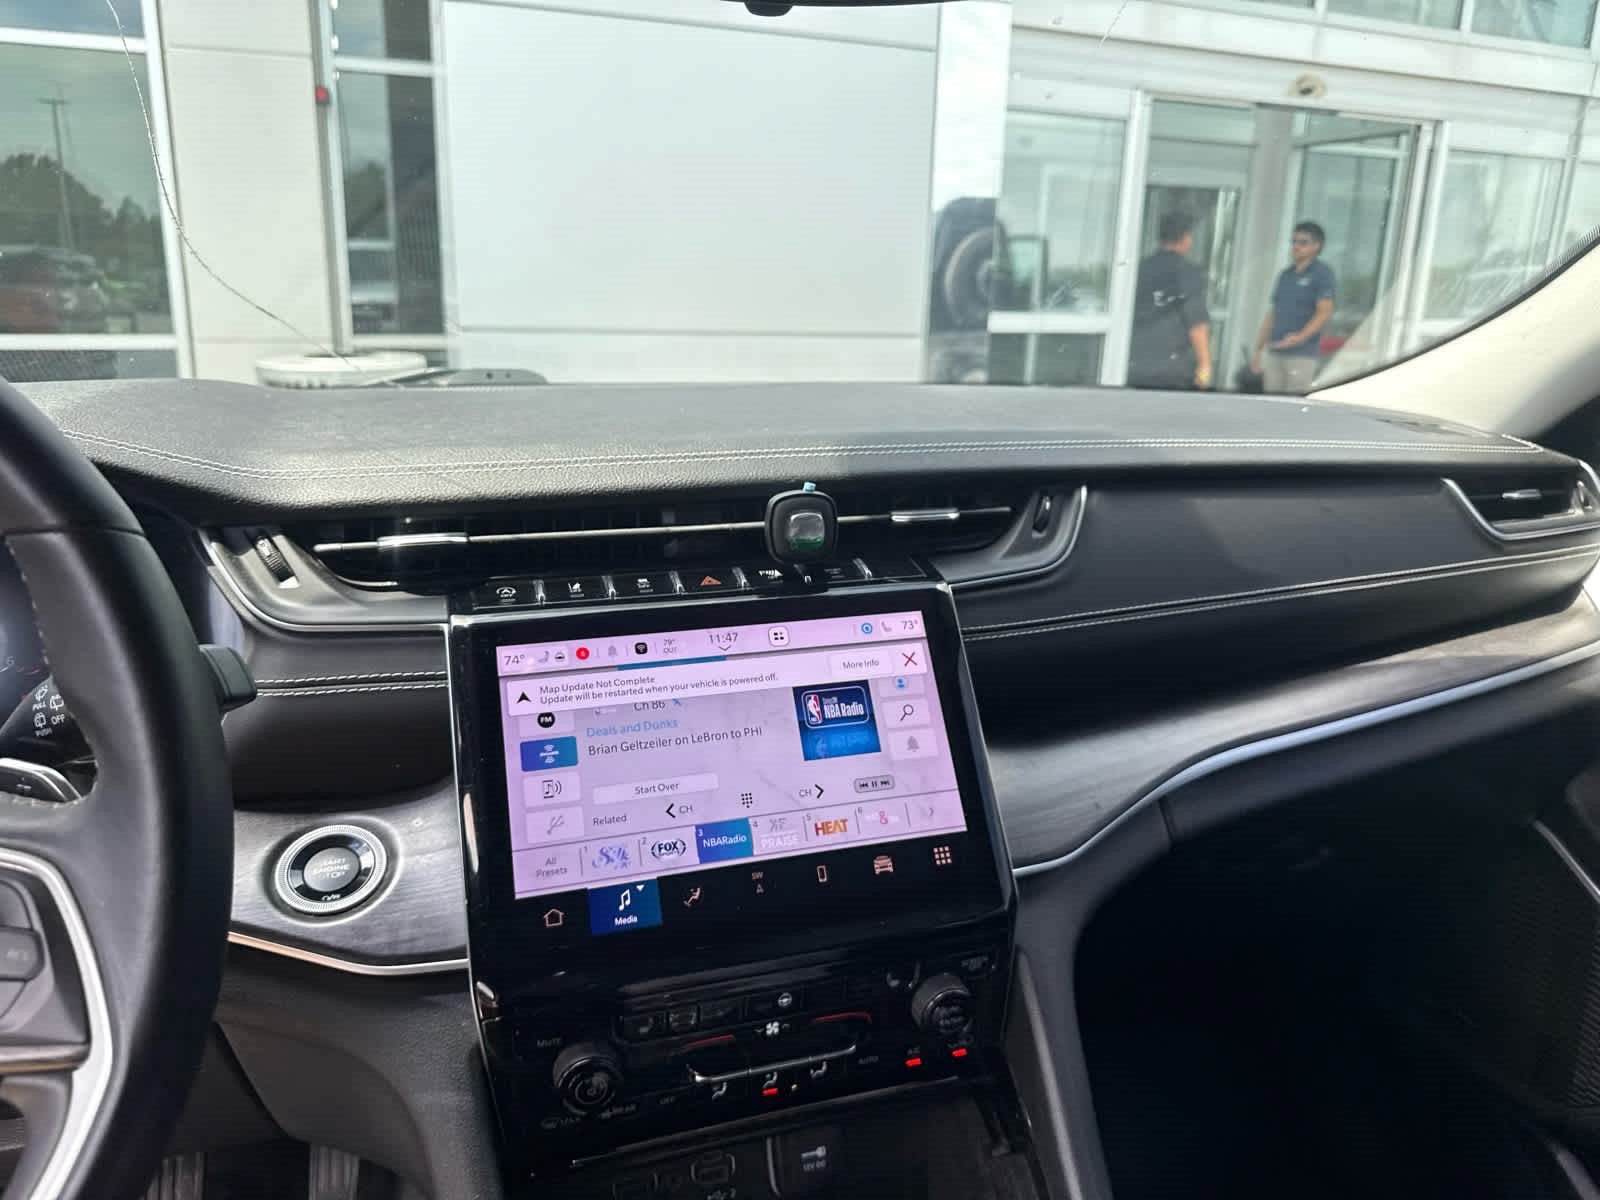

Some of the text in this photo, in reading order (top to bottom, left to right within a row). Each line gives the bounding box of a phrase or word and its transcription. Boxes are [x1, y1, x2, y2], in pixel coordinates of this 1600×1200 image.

[709, 632, 738, 645] 11:47
[504, 653, 525, 666] 74°
[843, 659, 879, 670] More Info
[540, 676, 655, 696] Map Update Not Complete
[540, 694, 573, 705] Update
[575, 692, 588, 701] will
[589, 691, 603, 700] be
[604, 687, 644, 698] restarted
[646, 685, 669, 694] when
[670, 683, 689, 694] your
[690, 679, 718, 690] vehicle
[729, 674, 763, 687] powered
[762, 673, 779, 683] off.
[824, 702, 865, 719] NBA Radio
[50, 713, 65, 725] OFF
[586, 719, 678, 738] Deals and Dunks
[588, 727, 762, 756] Brian Geltzeiler on LeBron to PHI
[635, 782, 679, 795] Start Over
[799, 789, 812, 798] CH
[679, 805, 693, 814] CH
[592, 813, 627, 826] Related
[815, 818, 849, 836] HEAT
[657, 840, 679, 853] FOX
[703, 834, 747, 848] NBARadio
[545, 856, 557, 866] All
[536, 866, 568, 879] Presets
[615, 915, 638, 926] Media
